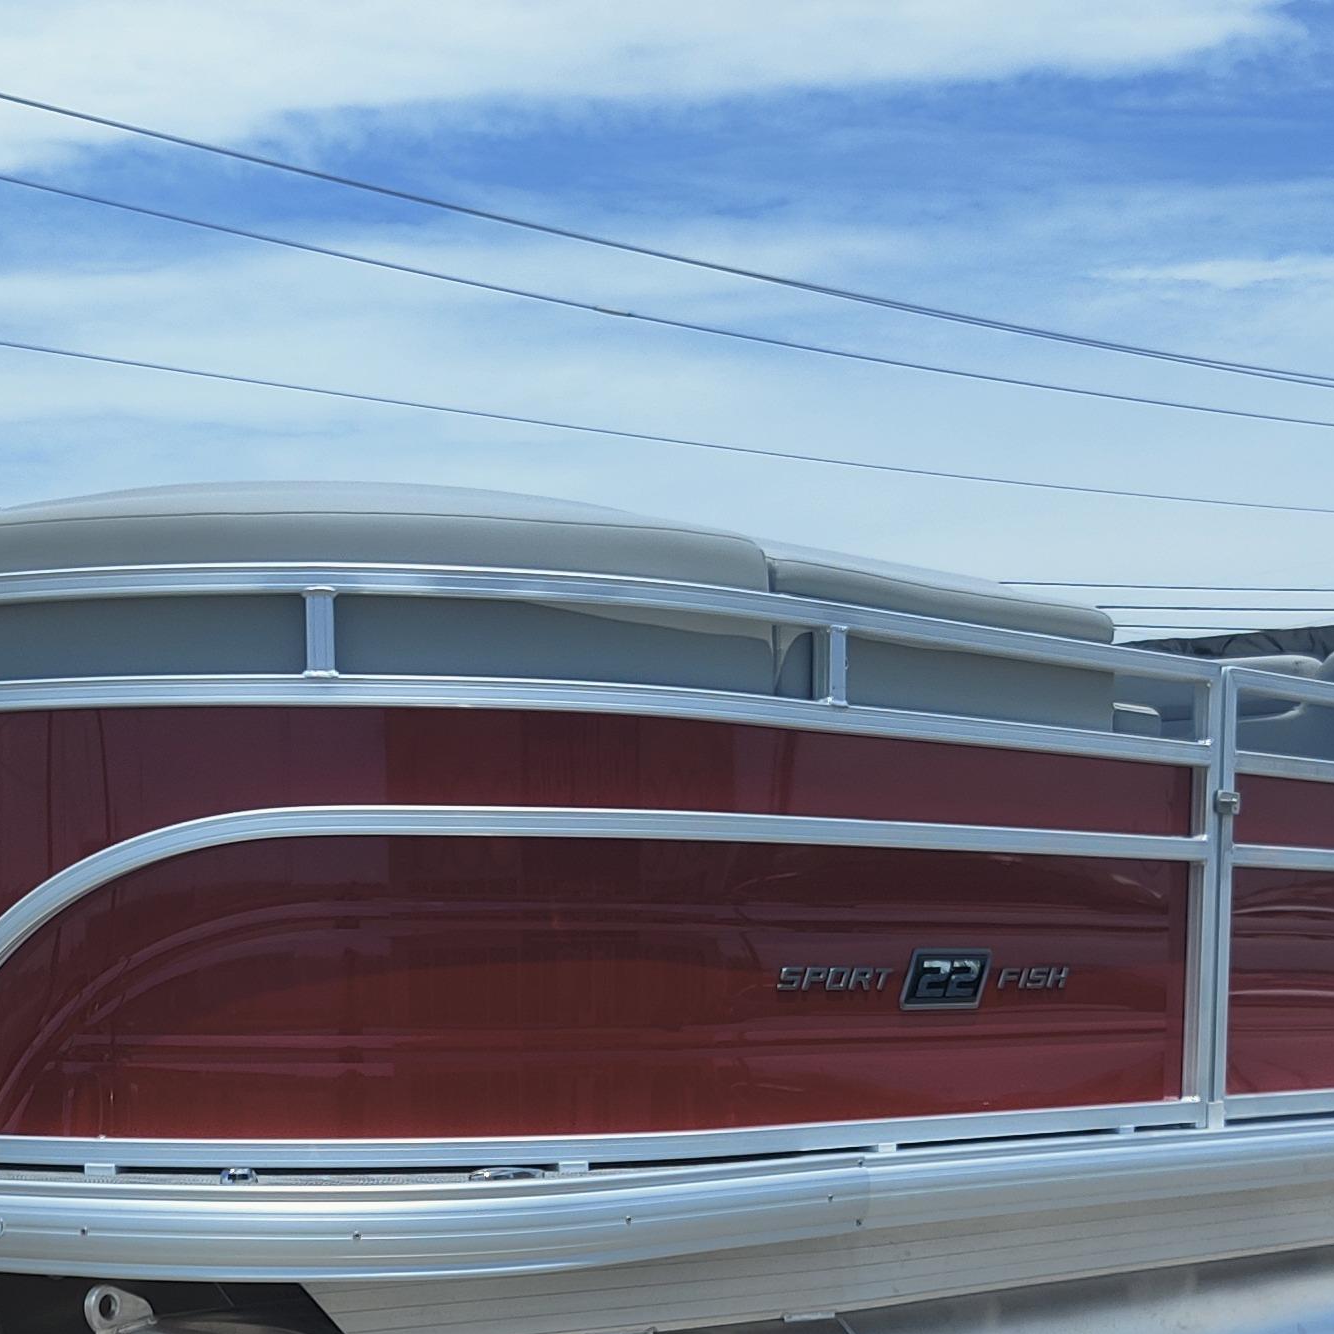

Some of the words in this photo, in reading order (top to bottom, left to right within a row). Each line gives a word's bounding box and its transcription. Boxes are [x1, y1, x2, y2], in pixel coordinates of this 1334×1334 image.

[777, 966, 894, 992] SPORT
[916, 959, 982, 998] 22
[997, 966, 1070, 990] FISH
